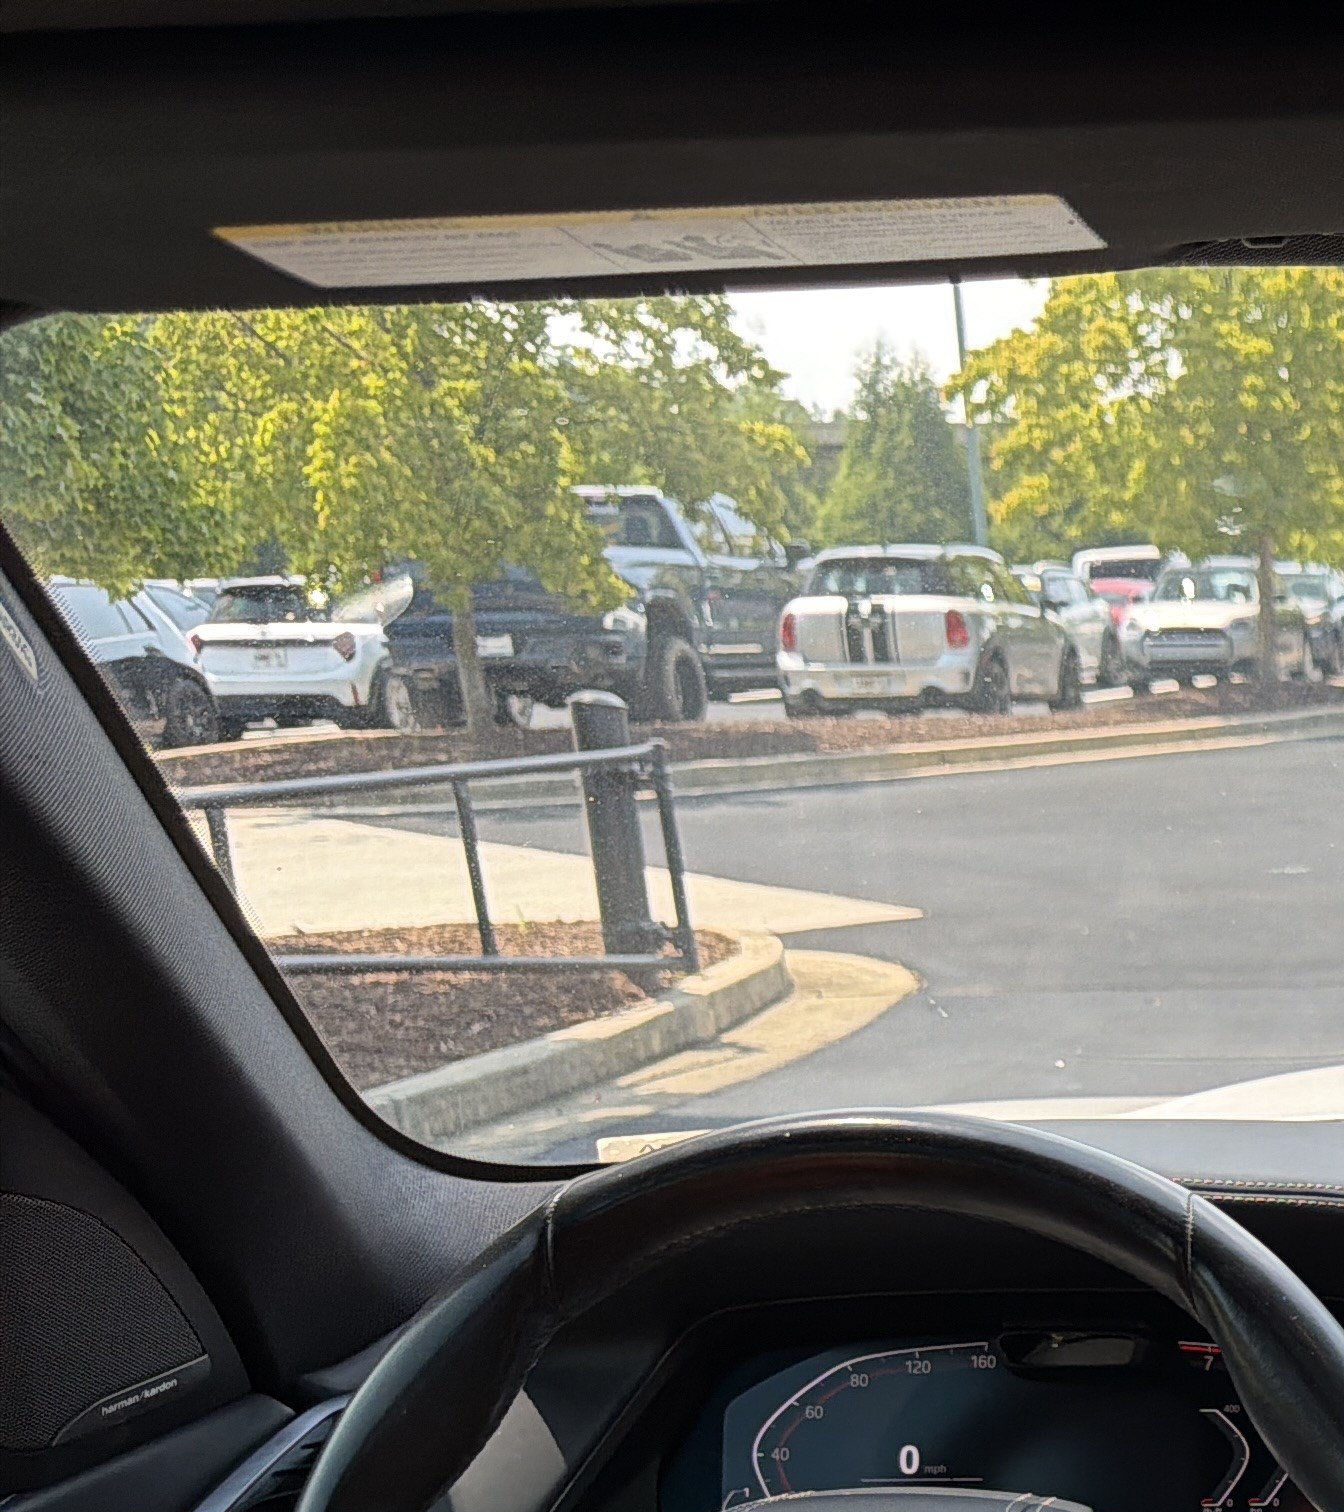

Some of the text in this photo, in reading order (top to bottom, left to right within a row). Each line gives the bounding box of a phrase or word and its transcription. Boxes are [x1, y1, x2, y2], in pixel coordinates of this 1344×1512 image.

[905, 1360, 931, 1374] 120
[971, 1355, 996, 1369] 160
[1203, 1355, 1214, 1371] 7
[850, 1373, 869, 1388] 80
[101, 1378, 178, 1416] harman/kardon
[805, 1405, 824, 1420] 60
[771, 1447, 789, 1461] 40
[900, 1445, 947, 1475] 0 mph
